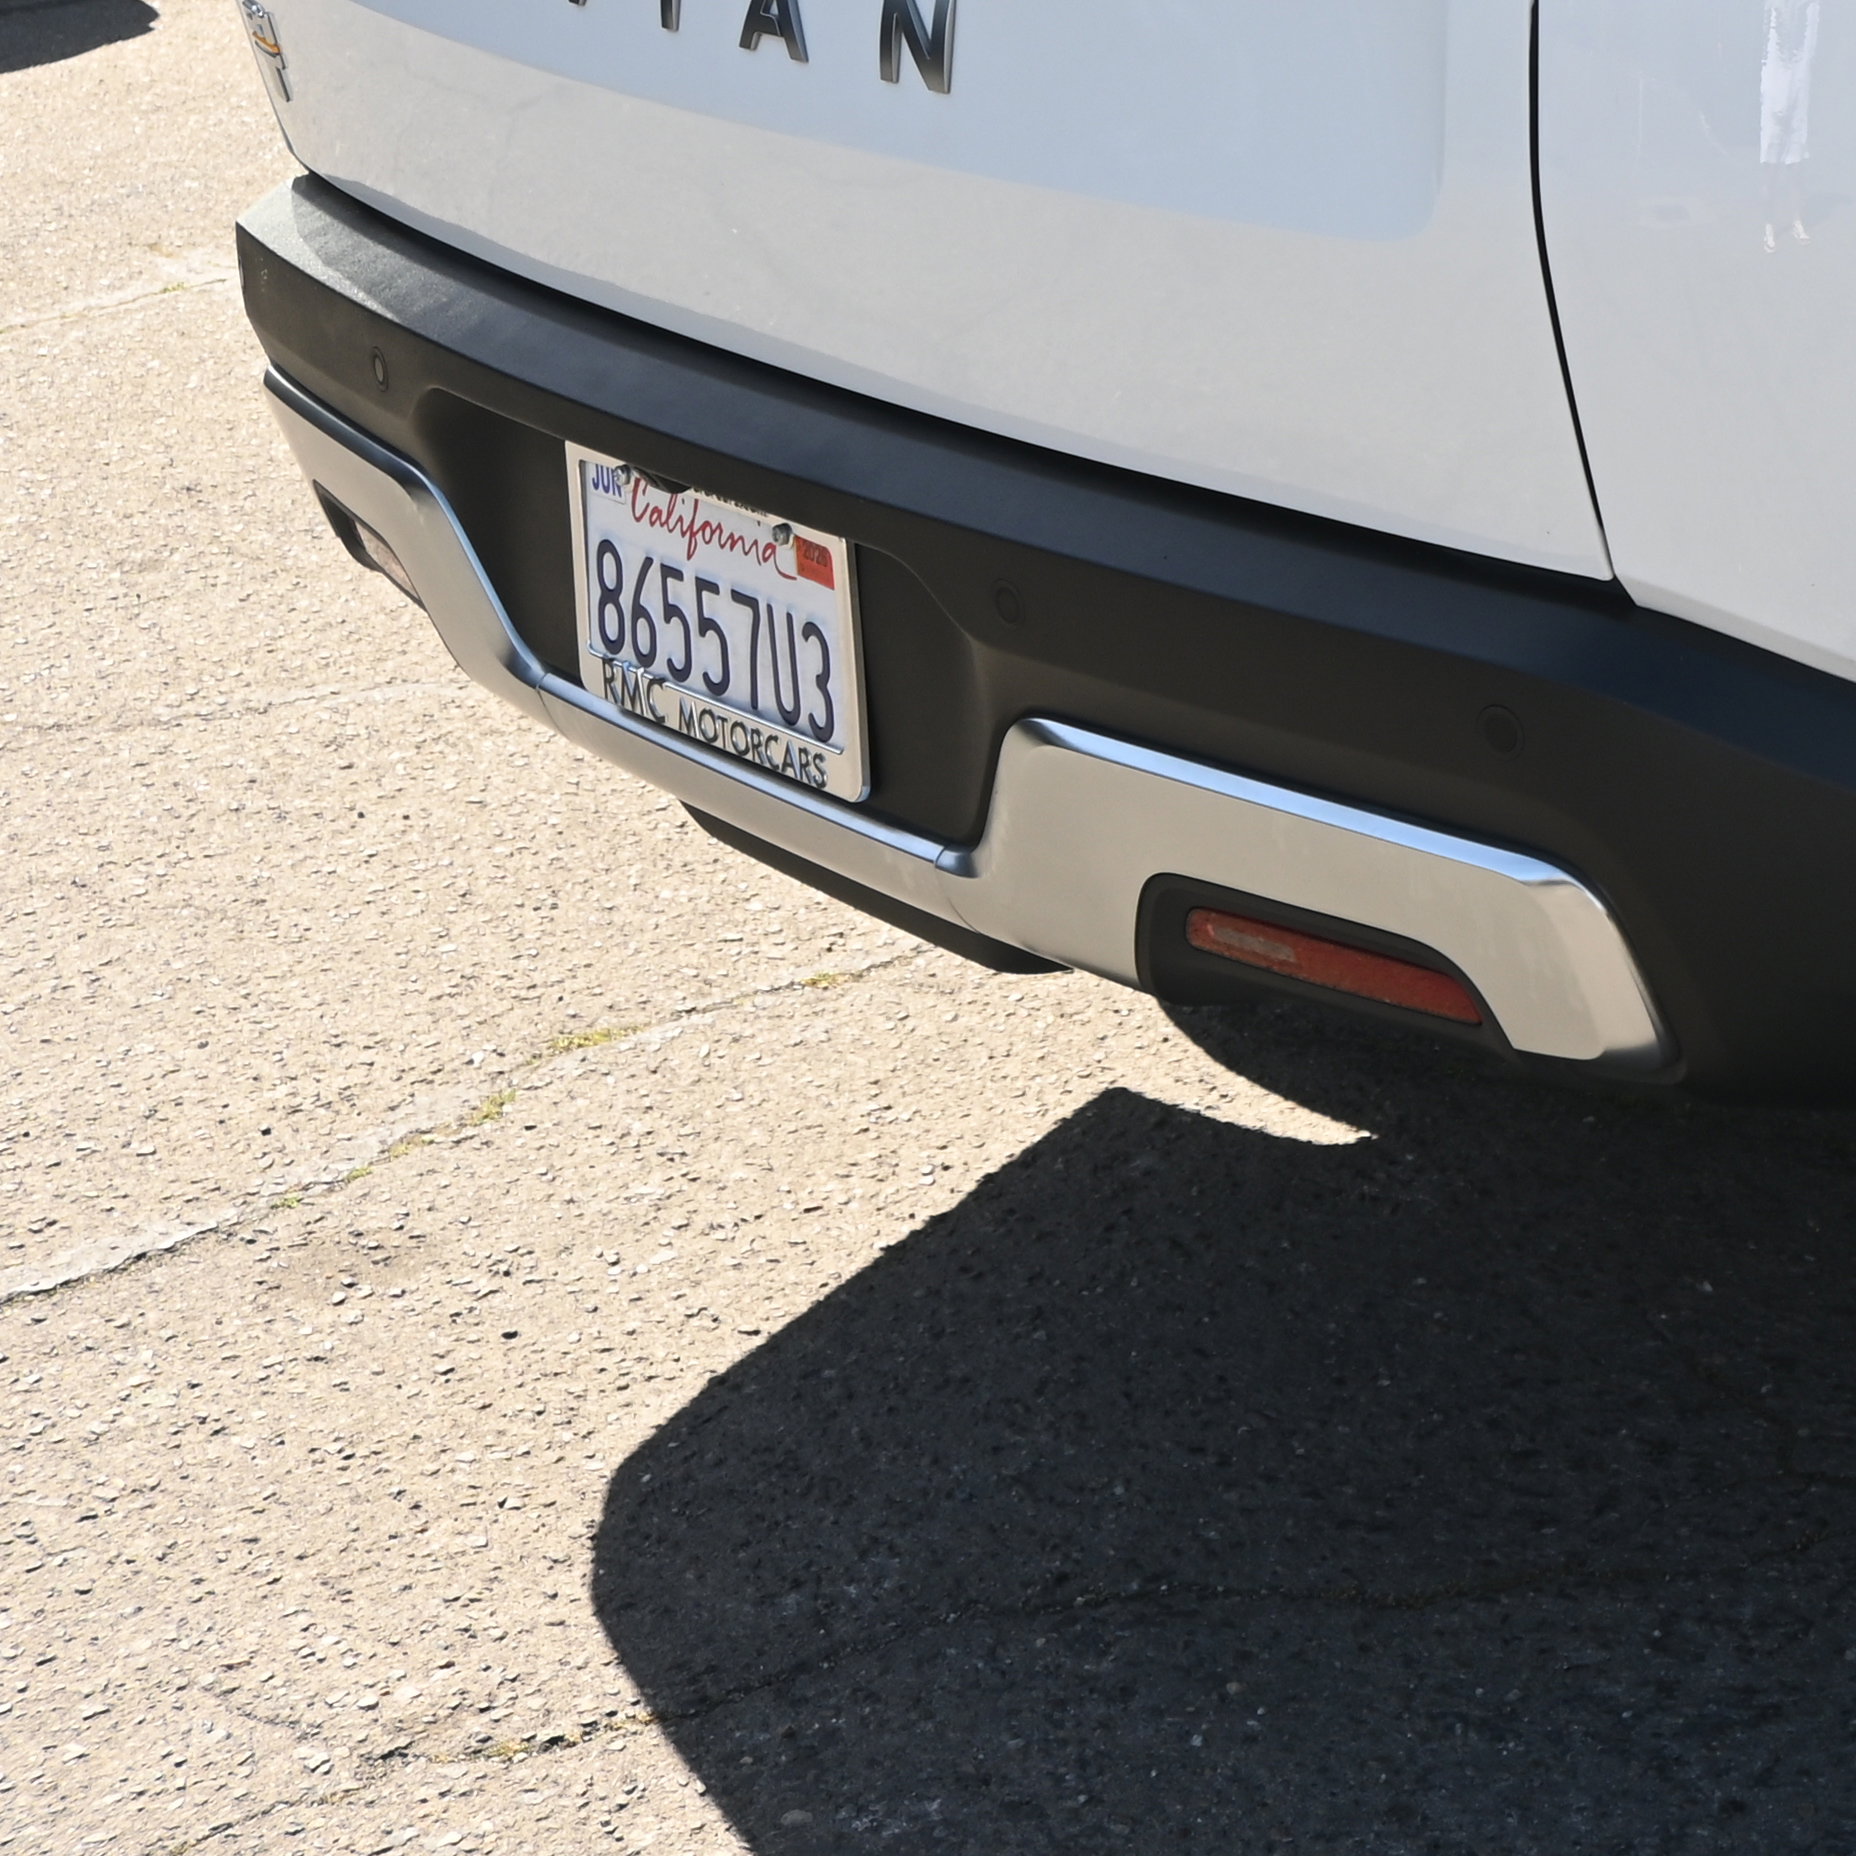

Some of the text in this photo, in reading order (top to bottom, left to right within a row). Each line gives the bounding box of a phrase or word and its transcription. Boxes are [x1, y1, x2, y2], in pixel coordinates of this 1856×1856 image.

[631, 477, 798, 581] California
[596, 539, 834, 743] 86557U3
[602, 657, 828, 791] RMC MOTORCARS
